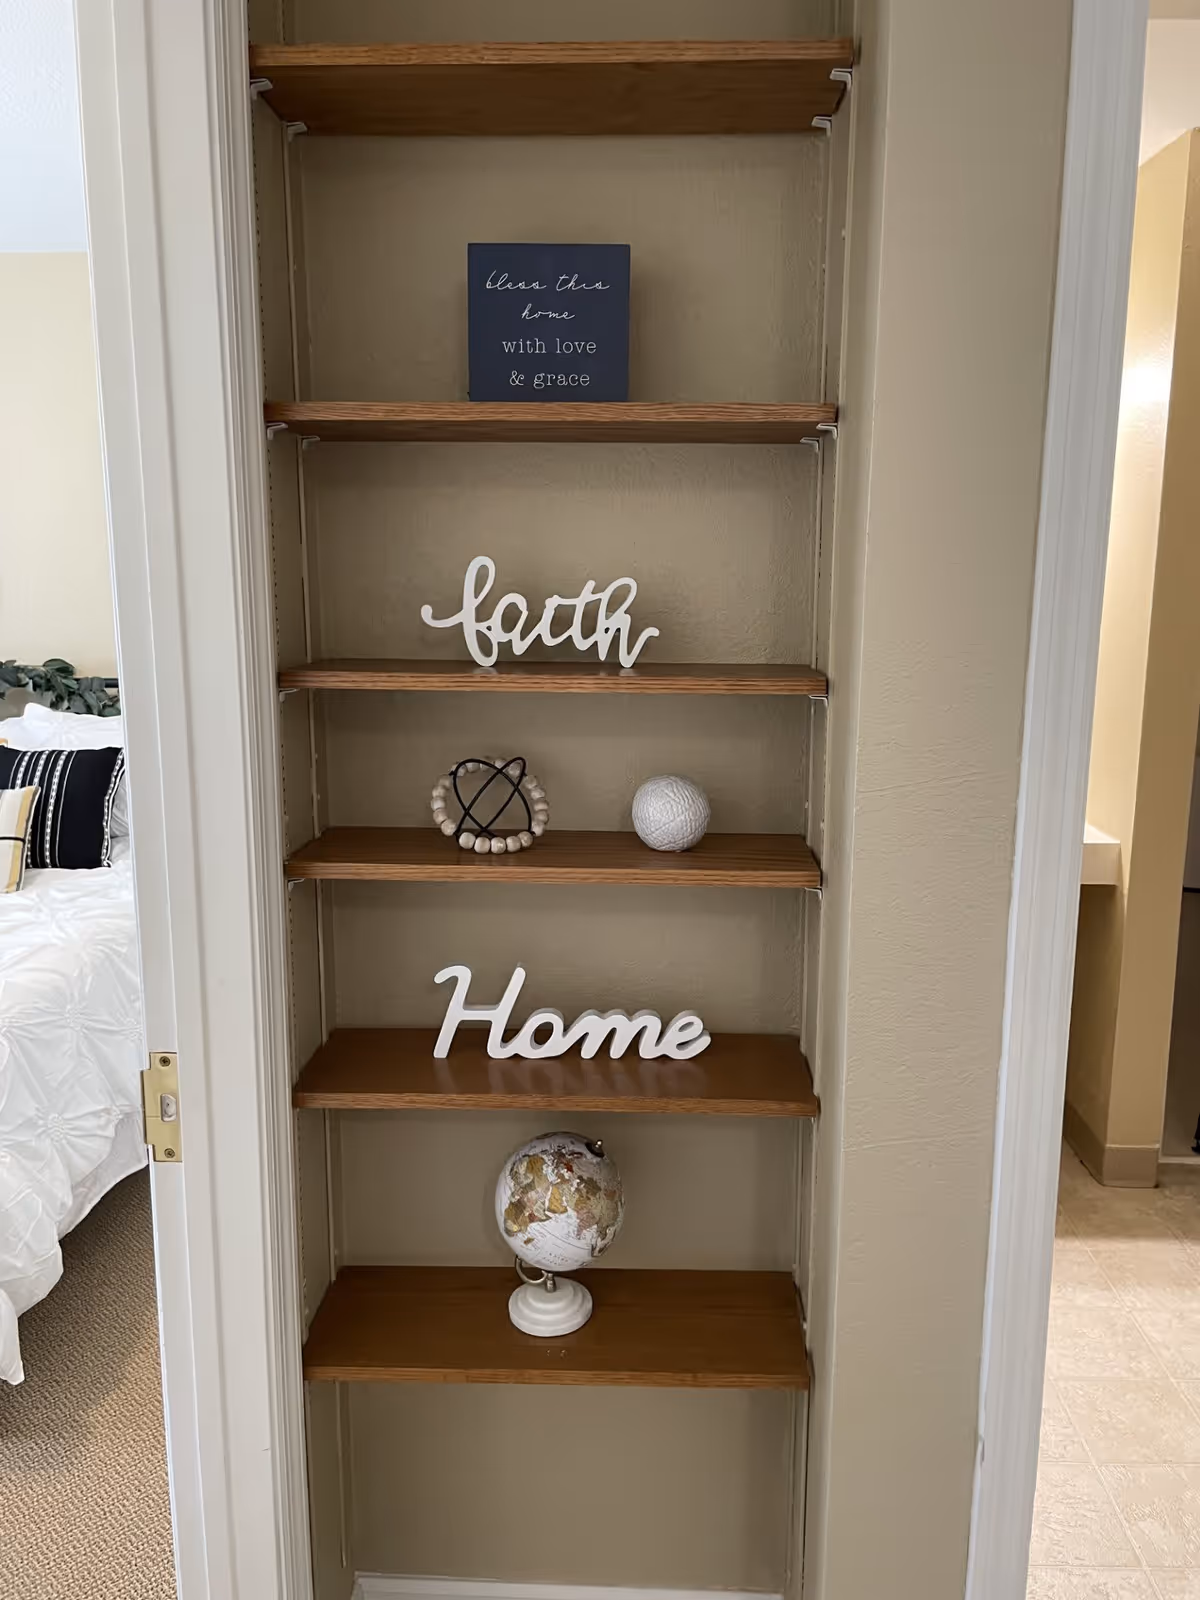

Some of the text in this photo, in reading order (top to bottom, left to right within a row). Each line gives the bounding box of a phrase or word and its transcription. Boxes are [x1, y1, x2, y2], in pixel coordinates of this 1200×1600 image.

[486, 270, 611, 291] bless this
[521, 303, 576, 320] home
[502, 338, 597, 354] with love
[509, 370, 590, 389] & grace
[421, 555, 660, 668] faith
[433, 964, 712, 1060] Home
